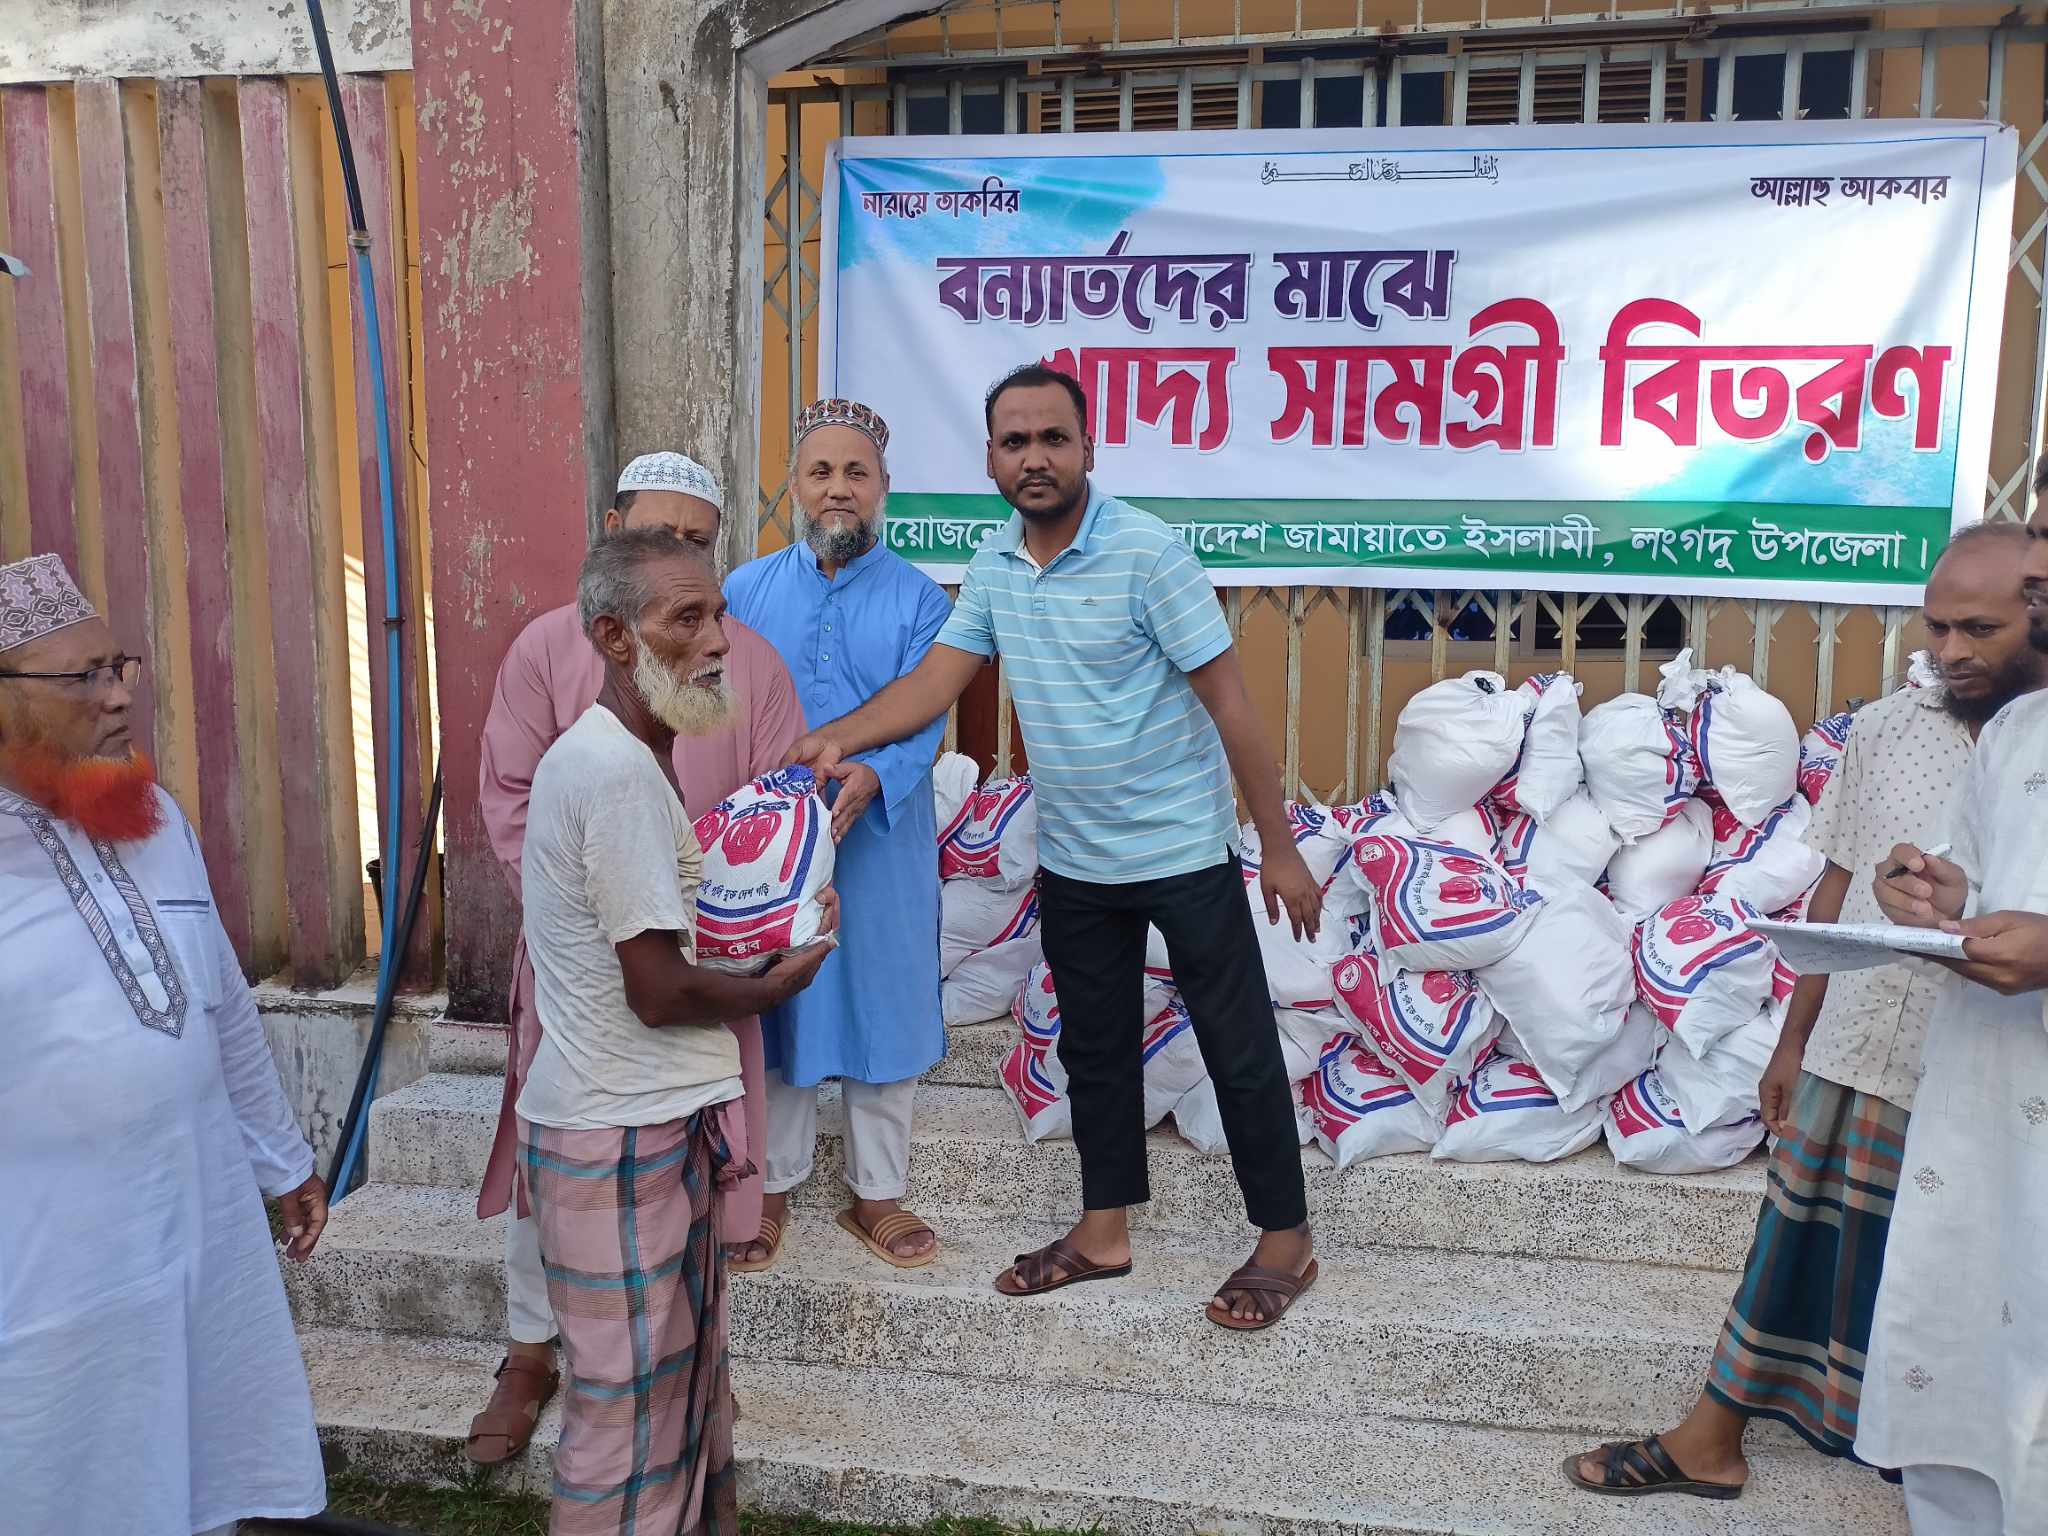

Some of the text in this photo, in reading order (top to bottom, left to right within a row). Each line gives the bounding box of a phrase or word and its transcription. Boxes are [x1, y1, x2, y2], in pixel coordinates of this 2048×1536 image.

[862, 175, 1021, 219] নারায়ে তাকবির
[1840, 175, 1951, 206] আকবার
[936, 231, 1456, 331] বন্যার্তদের মাঝে
[1266, 297, 1567, 451] সামগ্রী
[1598, 297, 1953, 463] বিতরণ
[883, 515, 1008, 550] য়োজনে
[1279, 520, 1452, 553] জামায়াতে
[1630, 524, 1739, 573] লংগদু
